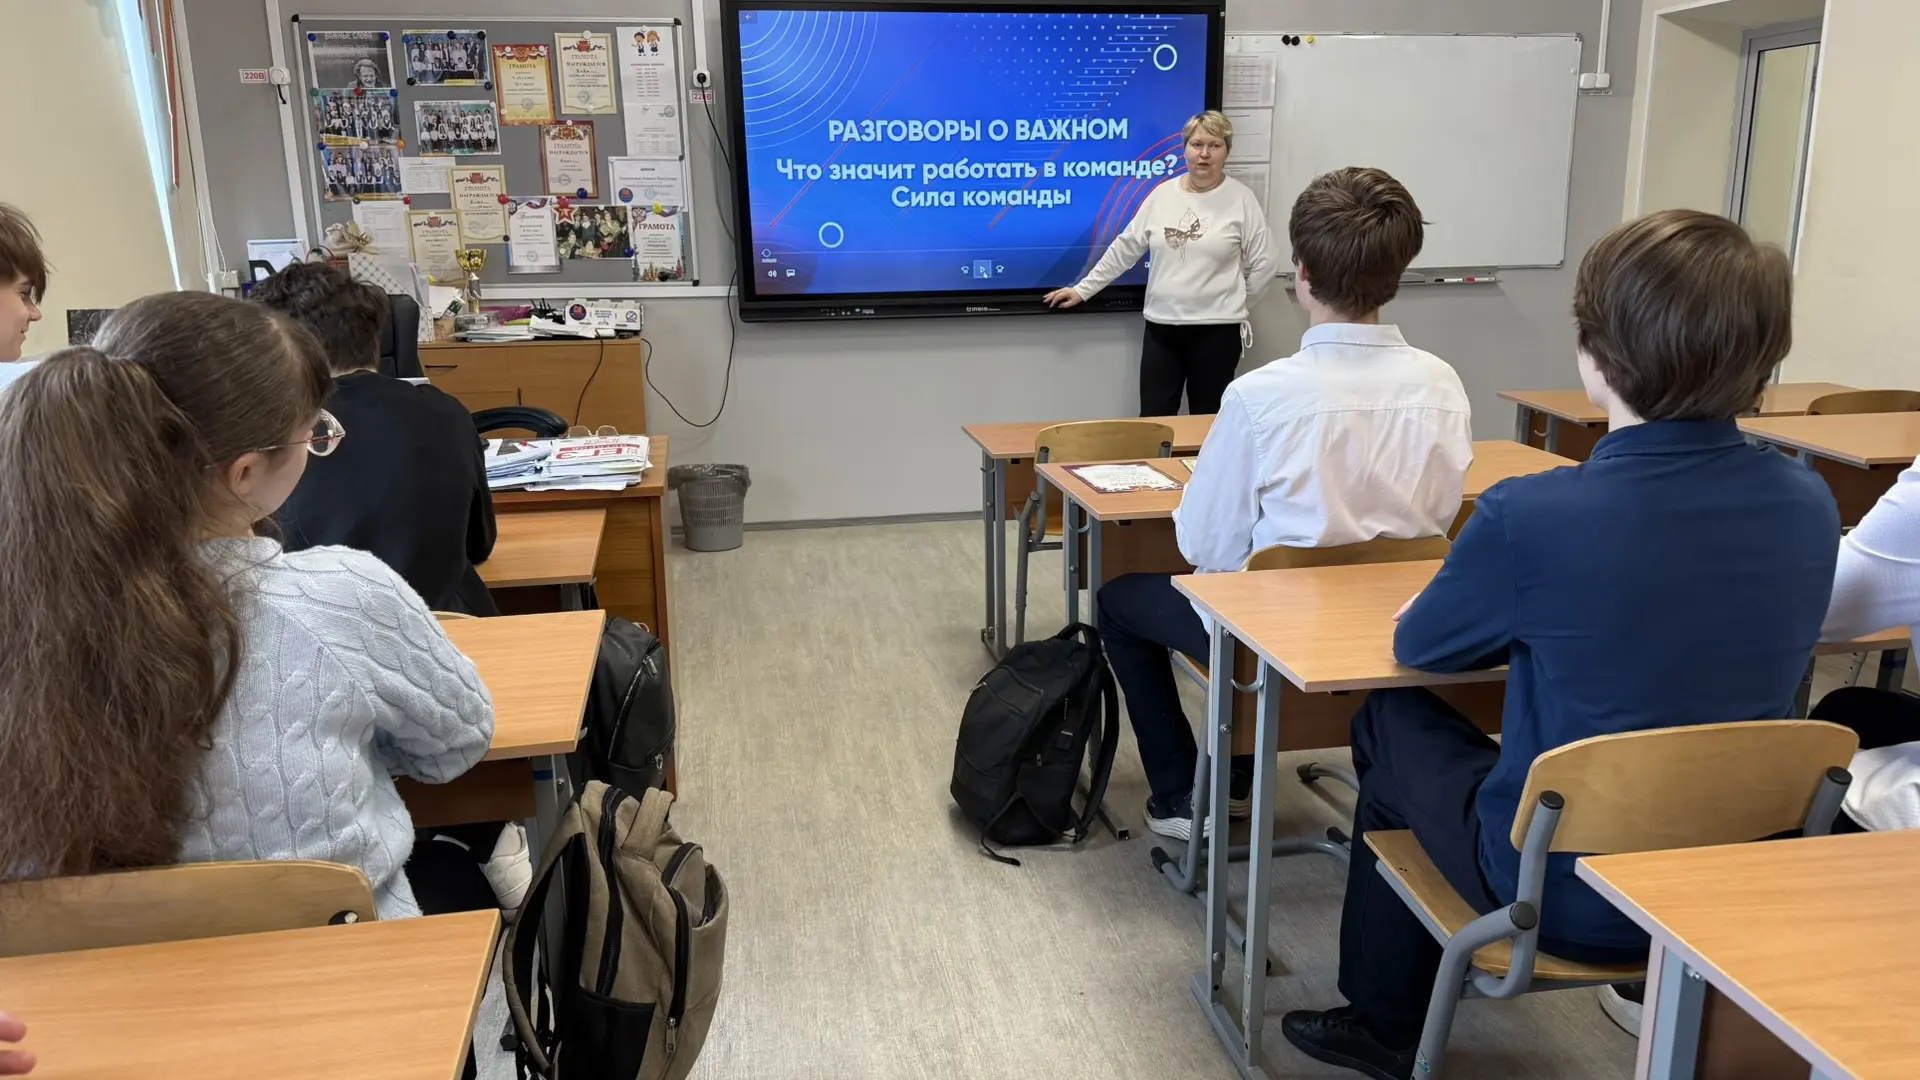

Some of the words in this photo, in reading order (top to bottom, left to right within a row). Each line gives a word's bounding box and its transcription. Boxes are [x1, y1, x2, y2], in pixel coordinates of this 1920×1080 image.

[828, 119, 982, 143] РАЗГОВОРЫ
[988, 119, 1009, 142] О
[1015, 117, 1128, 141] ВАЖНОМ
[776, 158, 822, 180] Что
[829, 163, 916, 180] значит
[922, 157, 1038, 184] работать
[1043, 162, 1057, 178] в
[1063, 154, 1178, 180] команде?
[891, 185, 955, 207] Сила
[963, 189, 1071, 208] команды
